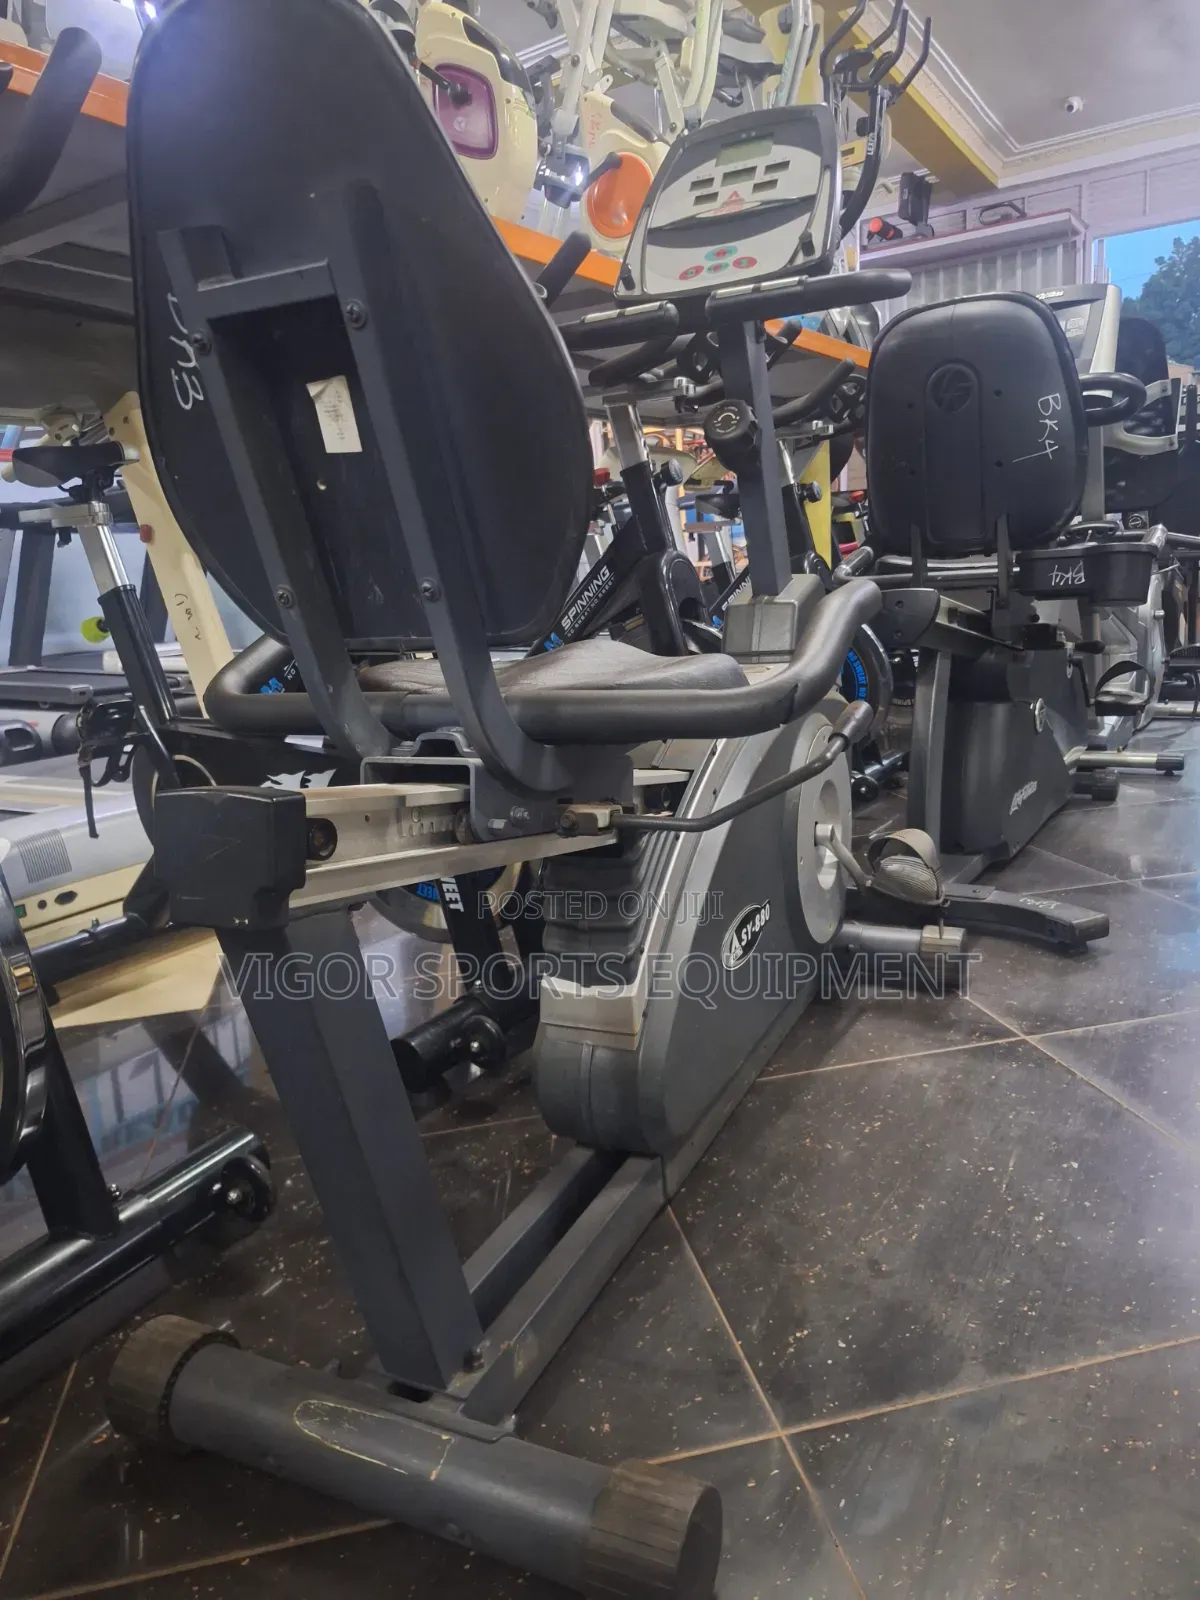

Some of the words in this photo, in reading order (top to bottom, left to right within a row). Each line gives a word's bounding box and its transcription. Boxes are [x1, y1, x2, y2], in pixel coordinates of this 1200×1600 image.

[1012, 393, 1062, 463] BK4
[561, 565, 611, 631] SPINNING
[1048, 560, 1086, 586] BK4
